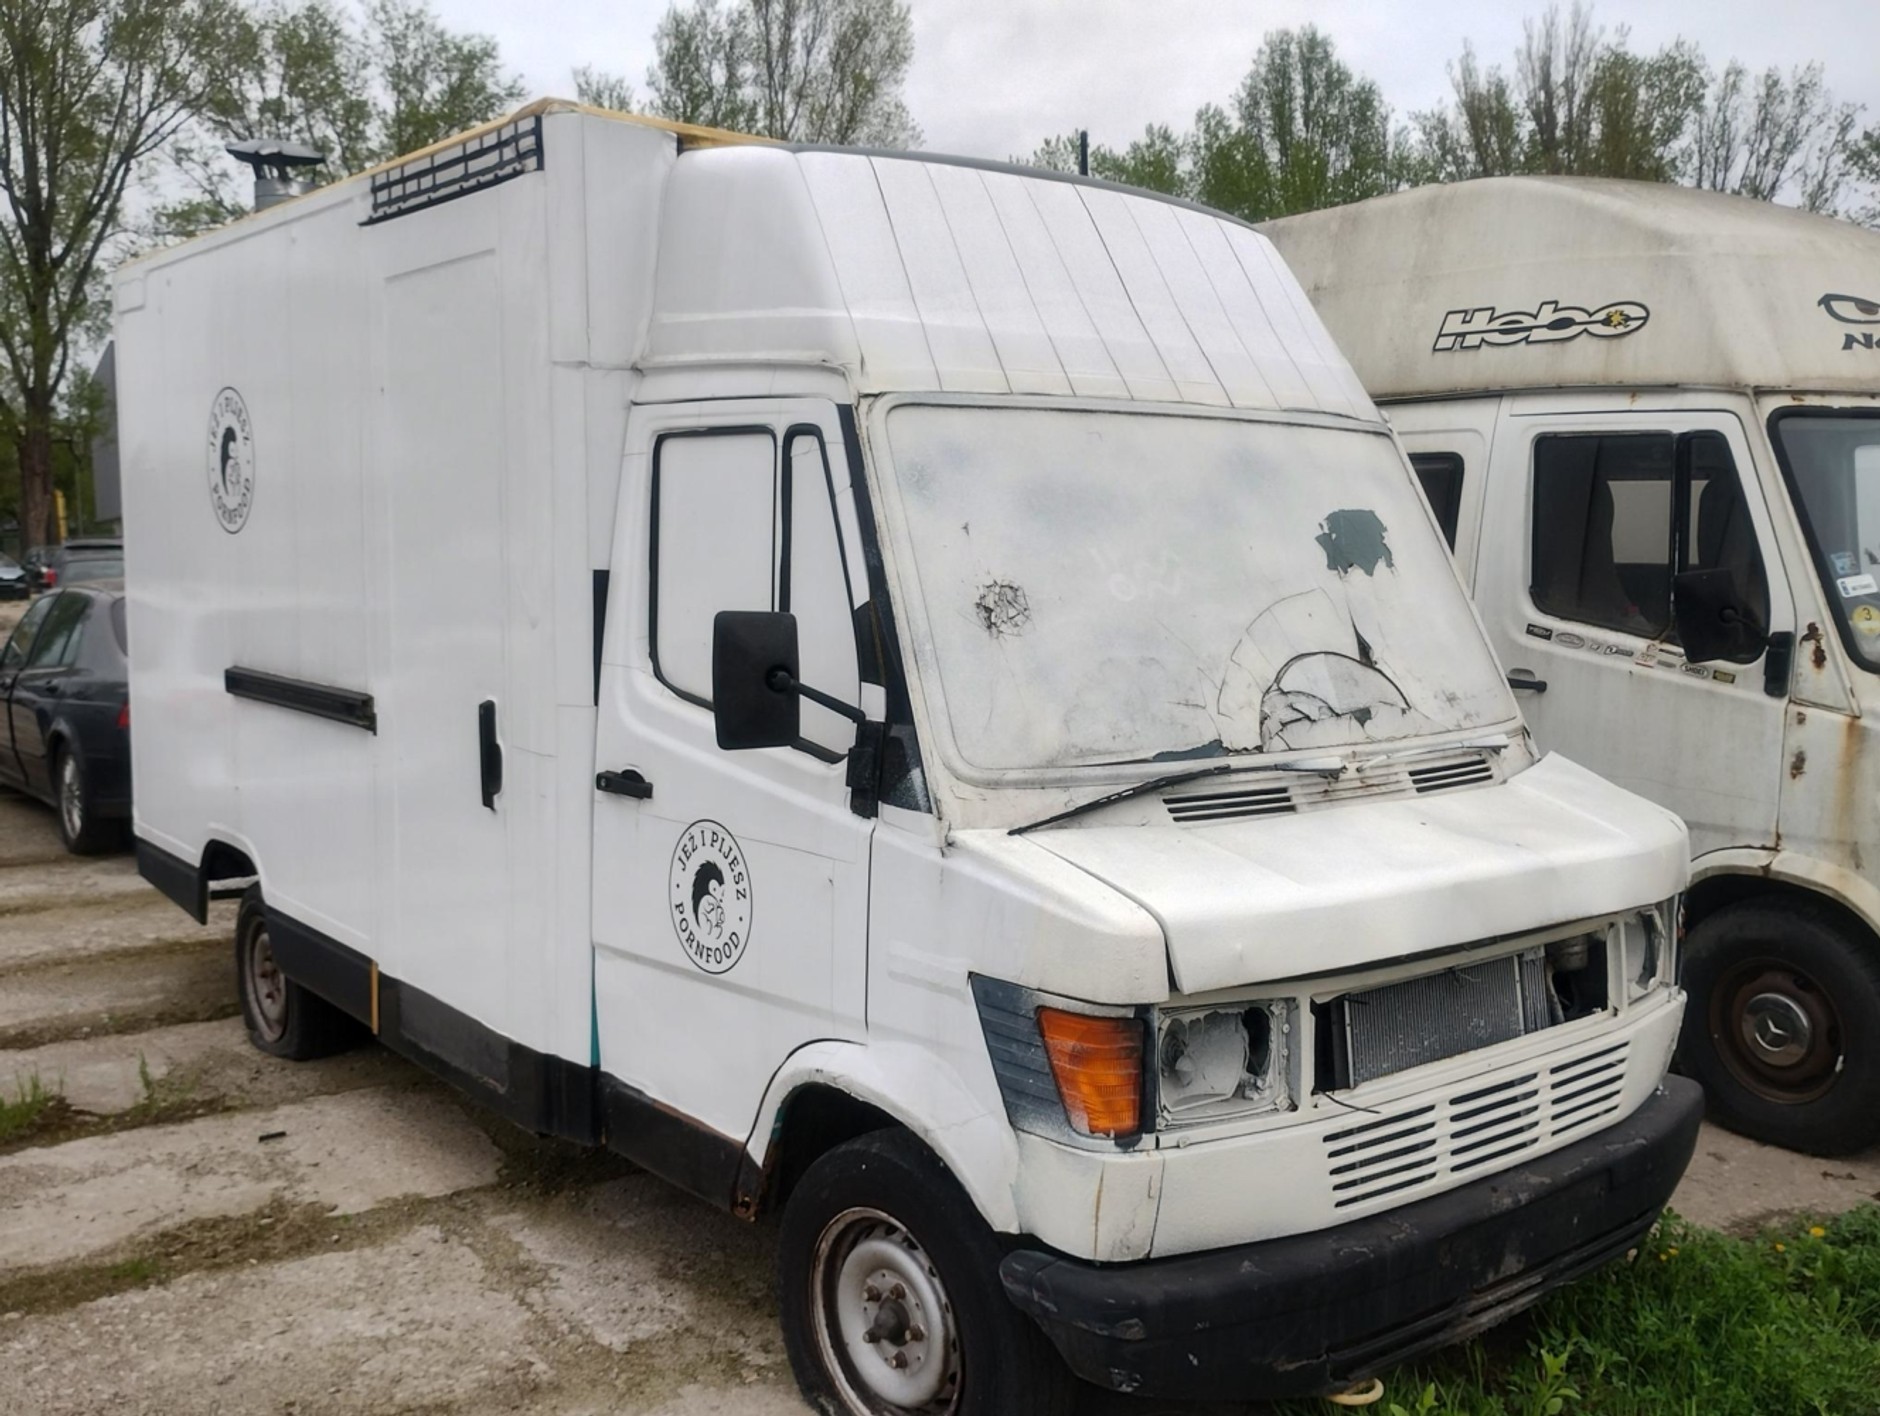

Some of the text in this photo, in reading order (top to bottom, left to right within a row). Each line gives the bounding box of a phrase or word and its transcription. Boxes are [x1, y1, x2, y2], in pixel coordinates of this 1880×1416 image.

[1432, 300, 1650, 352] Hebo
[1862, 607, 1873, 621] 3
[677, 830, 747, 901] JEŻ I PIJESZ
[674, 901, 740, 965] PORNFOOD
